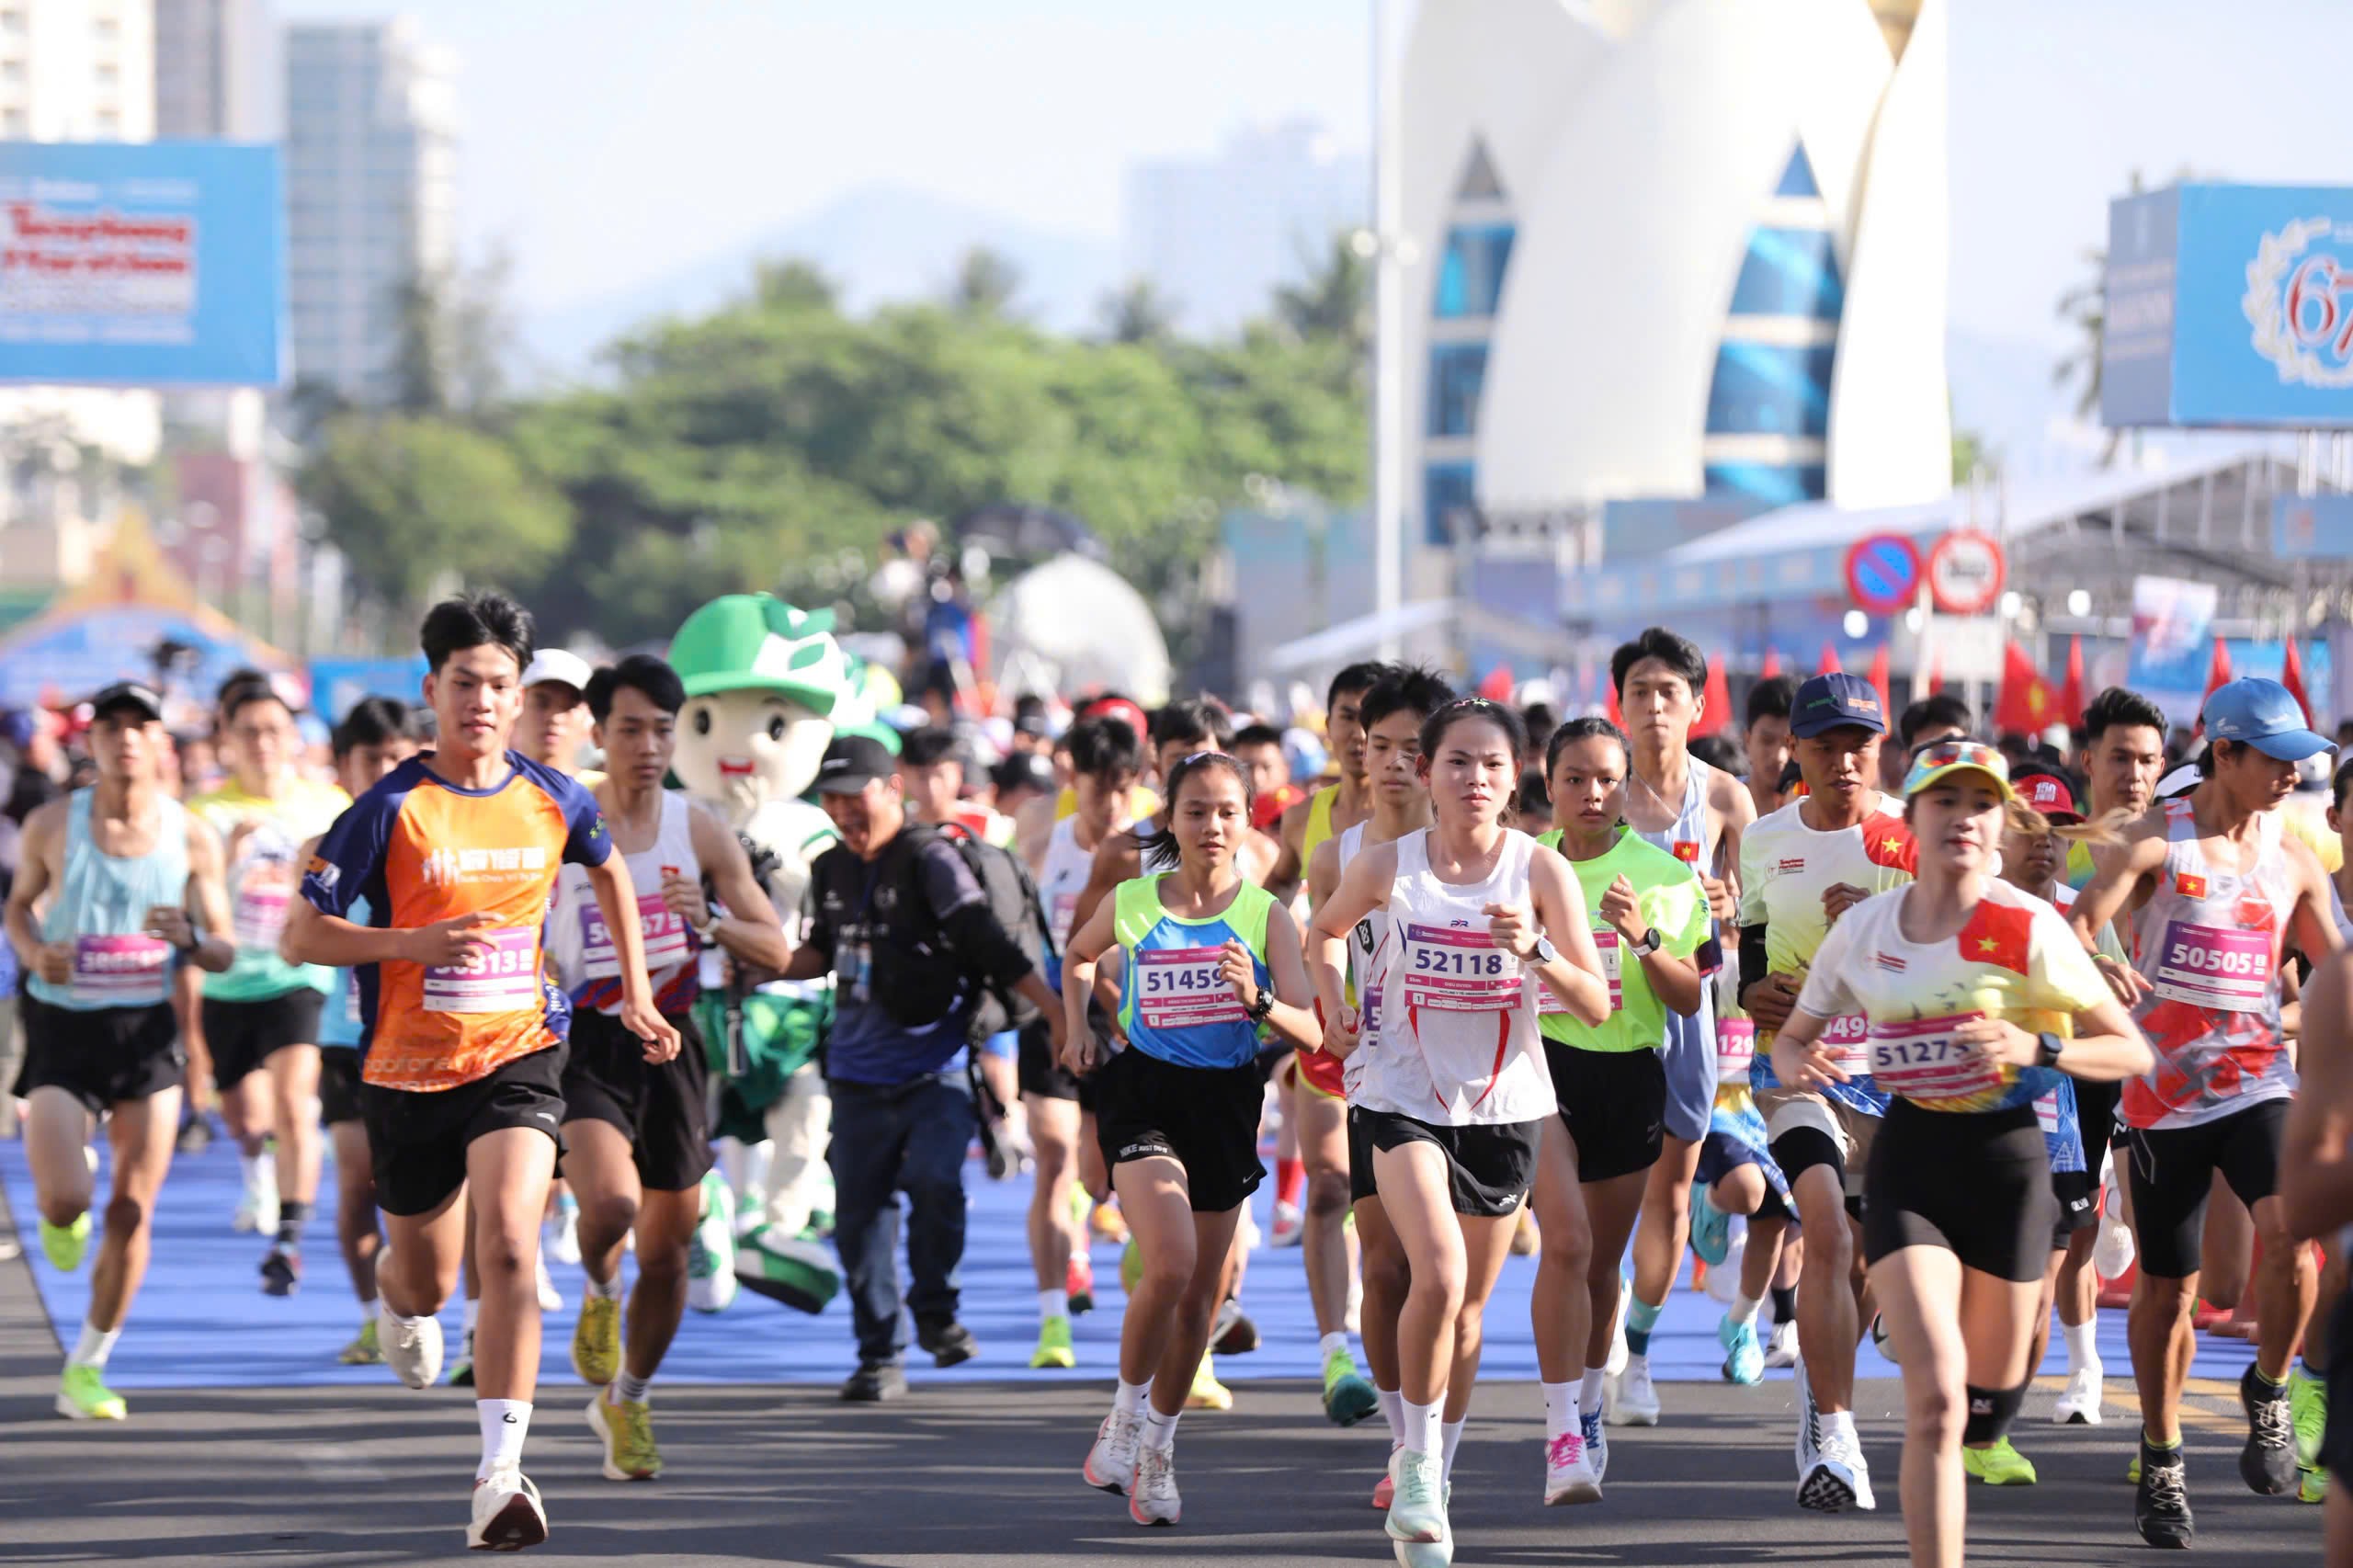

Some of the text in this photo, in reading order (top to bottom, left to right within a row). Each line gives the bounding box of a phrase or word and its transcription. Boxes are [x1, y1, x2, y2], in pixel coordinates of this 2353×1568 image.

[1415, 949, 1503, 975] 52118
[2169, 943, 2251, 974] 50505
[1147, 967, 1227, 992] 51459
